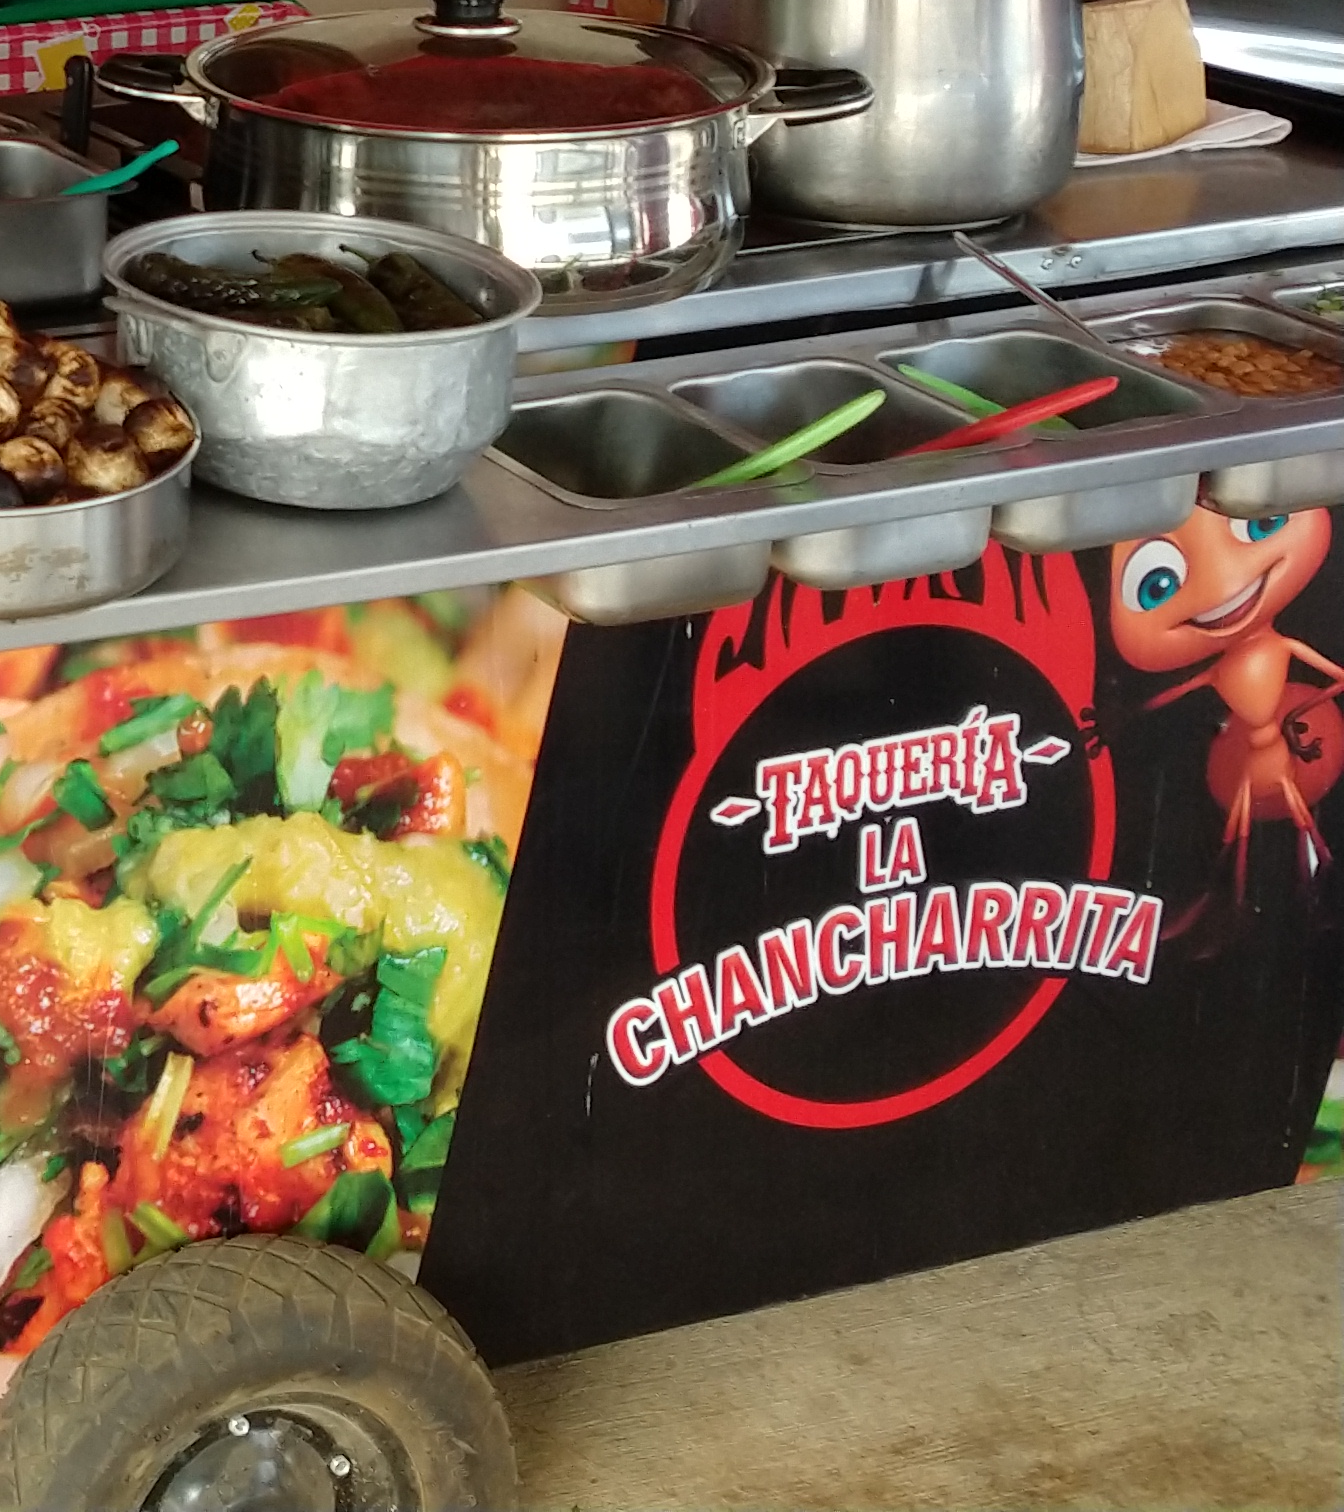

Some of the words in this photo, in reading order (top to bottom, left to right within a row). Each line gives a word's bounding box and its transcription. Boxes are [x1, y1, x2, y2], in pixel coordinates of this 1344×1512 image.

[756, 705, 1026, 854] TAQUERÍA
[859, 816, 925, 892] LA
[606, 881, 1163, 1087] CHANCHARRITA
